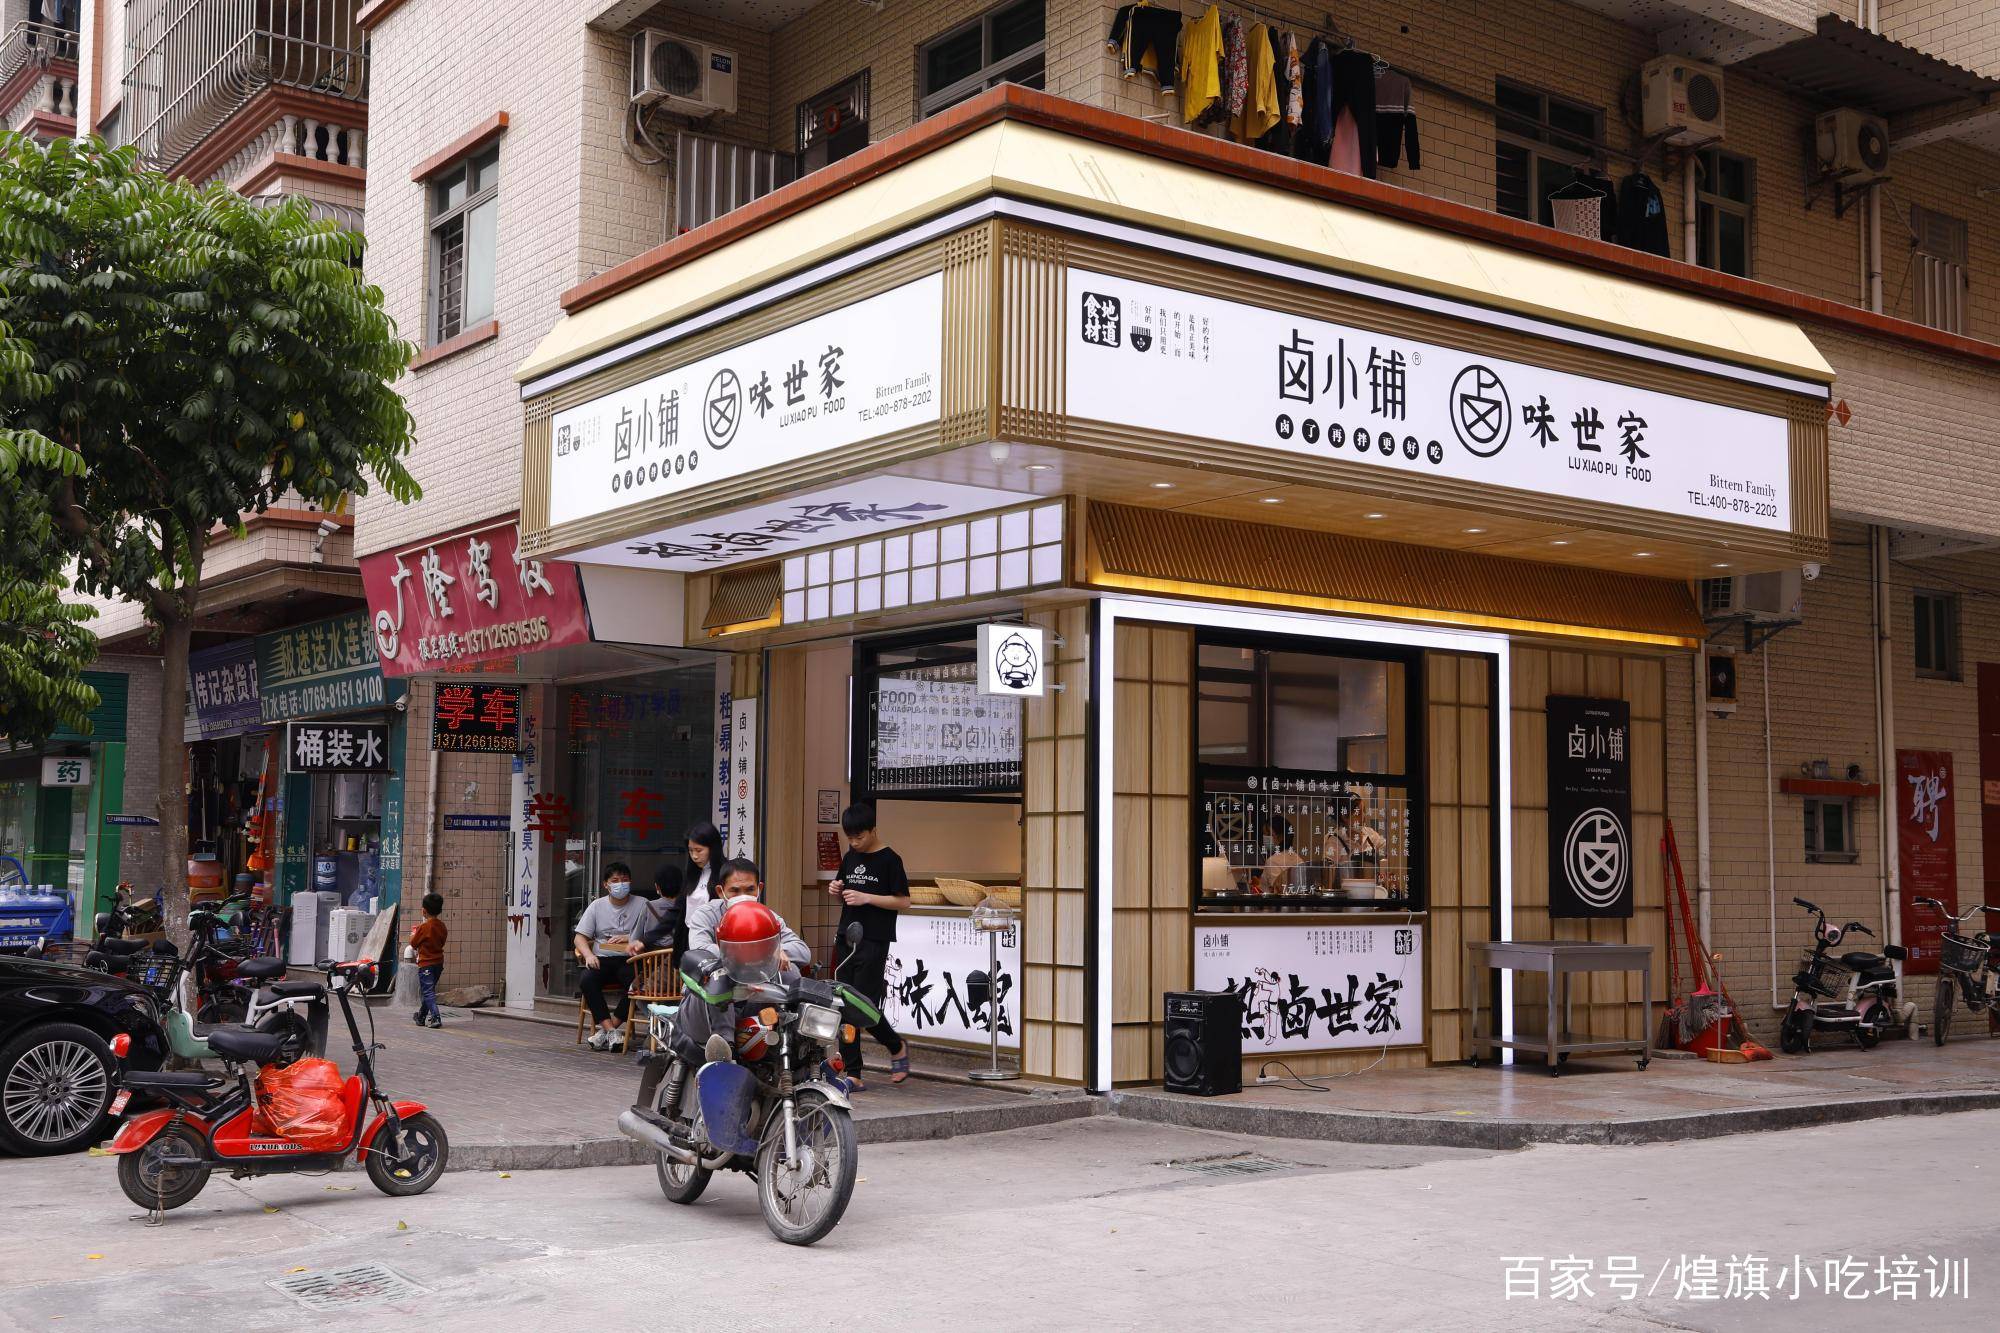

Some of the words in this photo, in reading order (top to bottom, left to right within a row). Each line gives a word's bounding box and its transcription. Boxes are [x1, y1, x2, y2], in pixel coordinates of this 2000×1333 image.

[875, 382, 904, 400] Bittern
[904, 371, 932, 391] Family
[1279, 328, 1407, 422] 卤小铺
[823, 396, 846, 416] FOOD
[858, 390, 932, 423] TEL:400-878-2202
[613, 389, 679, 464] 卤小铺
[1276, 414, 1443, 463] 卤了再拌更好吃
[1625, 465, 1652, 483] FOOD
[1709, 473, 1744, 492] Bittern
[1745, 480, 1777, 502] Family
[1688, 490, 1777, 518] TEL:400-878-2202
[355, 674, 383, 706] 9100
[436, 687, 517, 731] 学车
[296, 727, 383, 768] 桶装水
[1568, 723, 1624, 762] 卤小铺
[56, 760, 83, 784] 药
